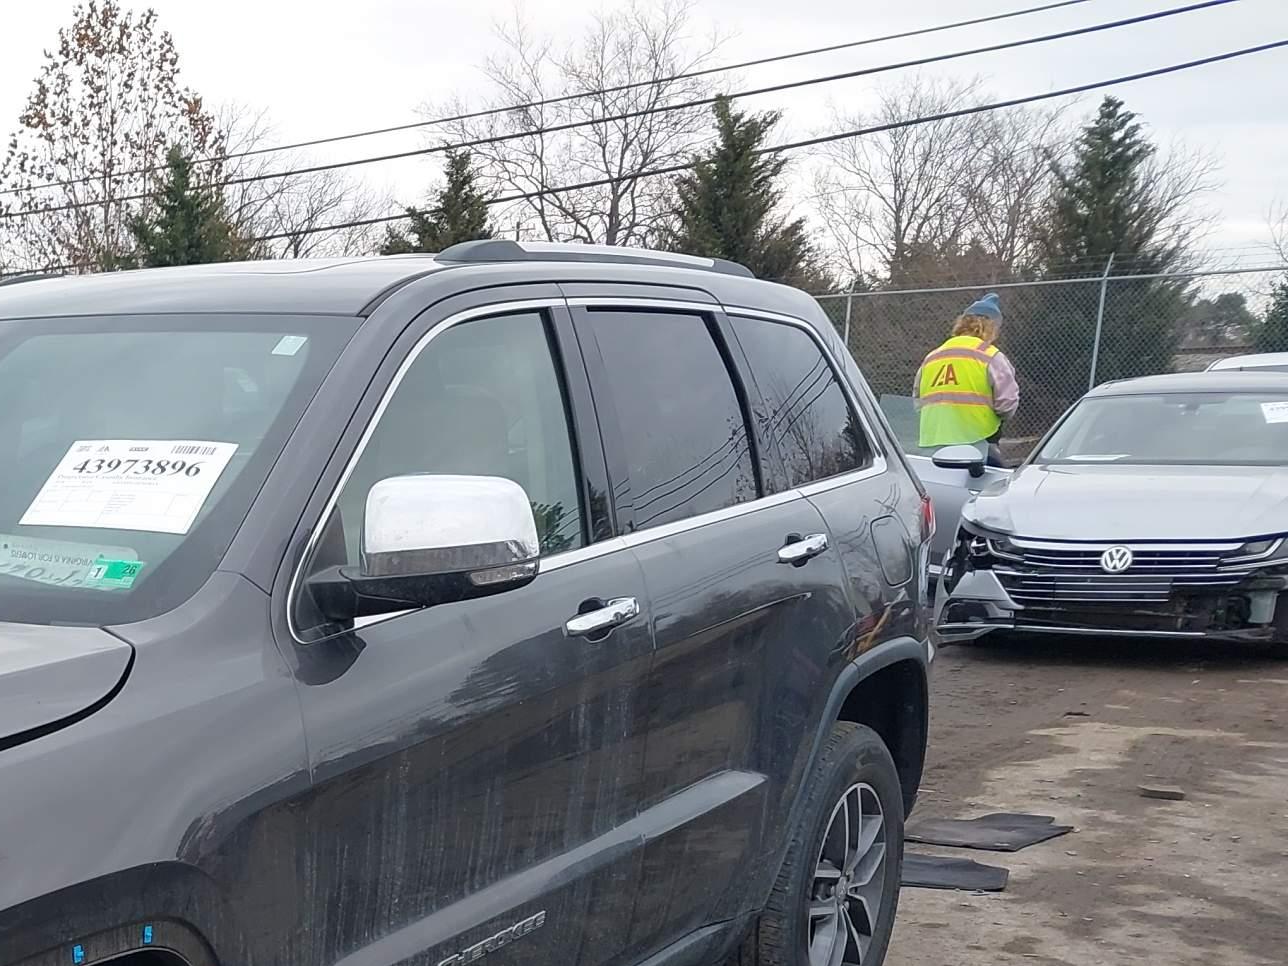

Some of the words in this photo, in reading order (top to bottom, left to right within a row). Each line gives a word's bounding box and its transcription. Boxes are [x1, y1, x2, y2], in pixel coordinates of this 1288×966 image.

[73, 459, 207, 477] 43973896
[39, 553, 54, 562] FOR
[62, 557, 93, 567] VIRGINIA
[122, 564, 136, 575] 26
